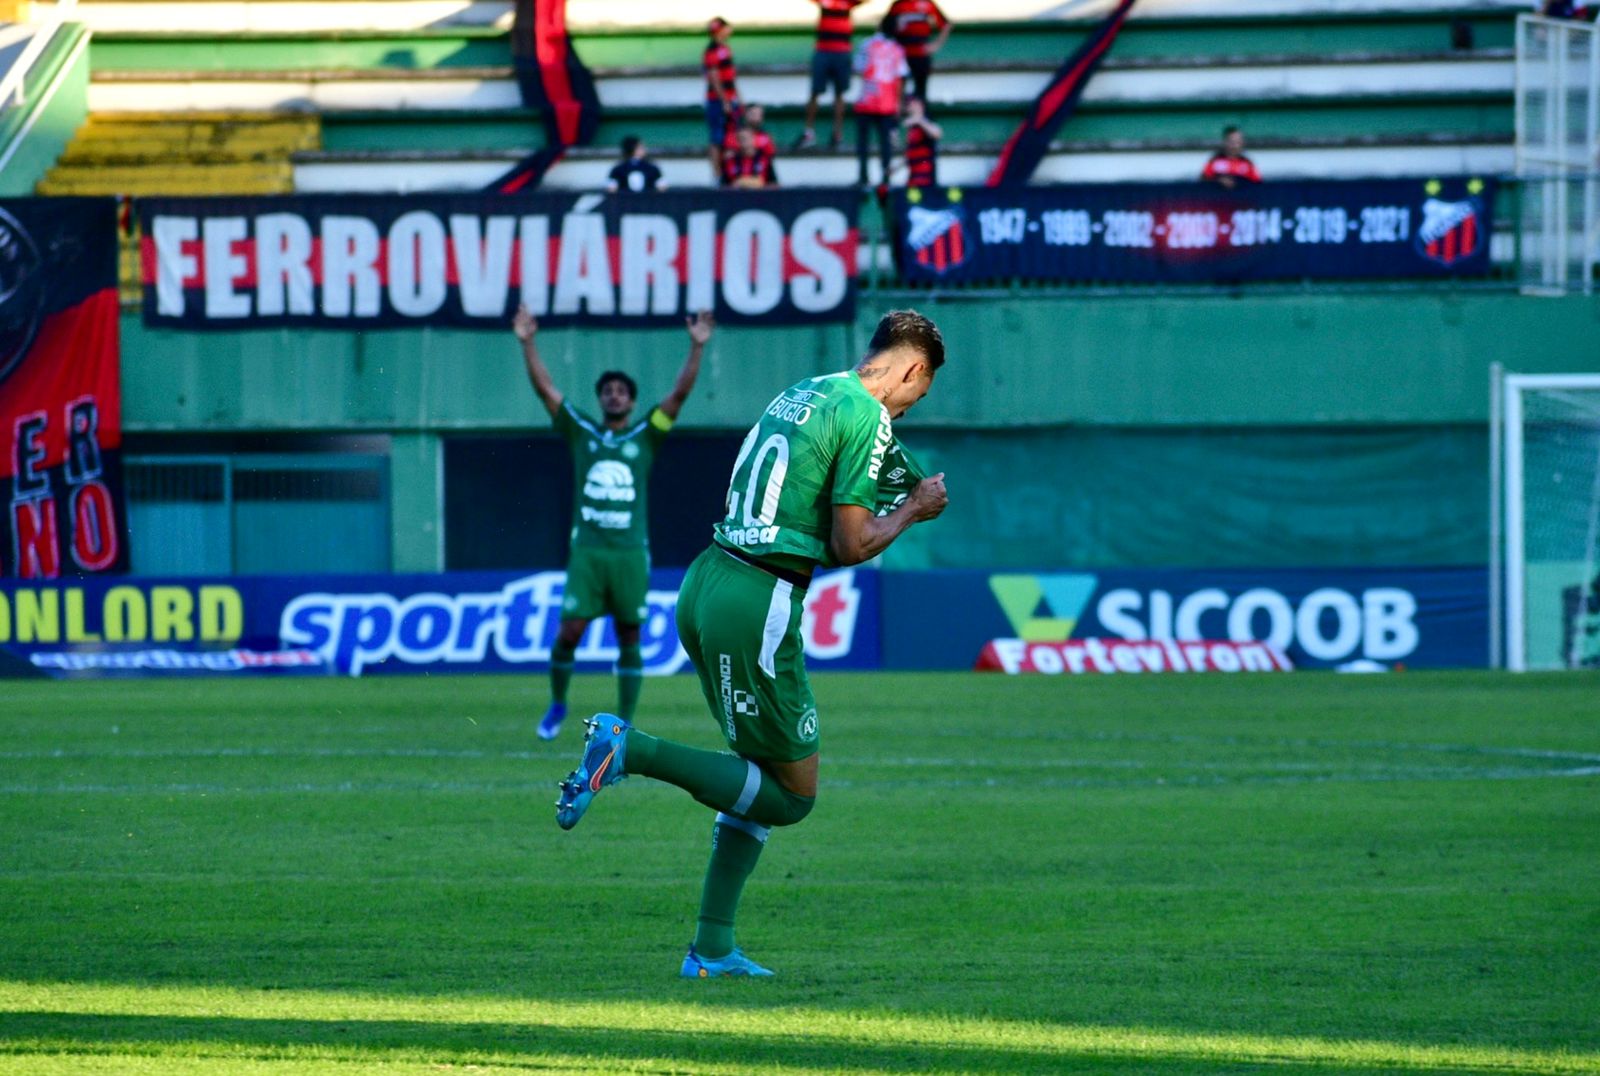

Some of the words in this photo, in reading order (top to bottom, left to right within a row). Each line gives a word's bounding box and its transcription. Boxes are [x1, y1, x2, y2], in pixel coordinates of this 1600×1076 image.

[152, 194, 849, 318] FERROVIÁRIOS
[0, 585, 243, 642] NLORD
[1098, 588, 1419, 660] SICOOB
